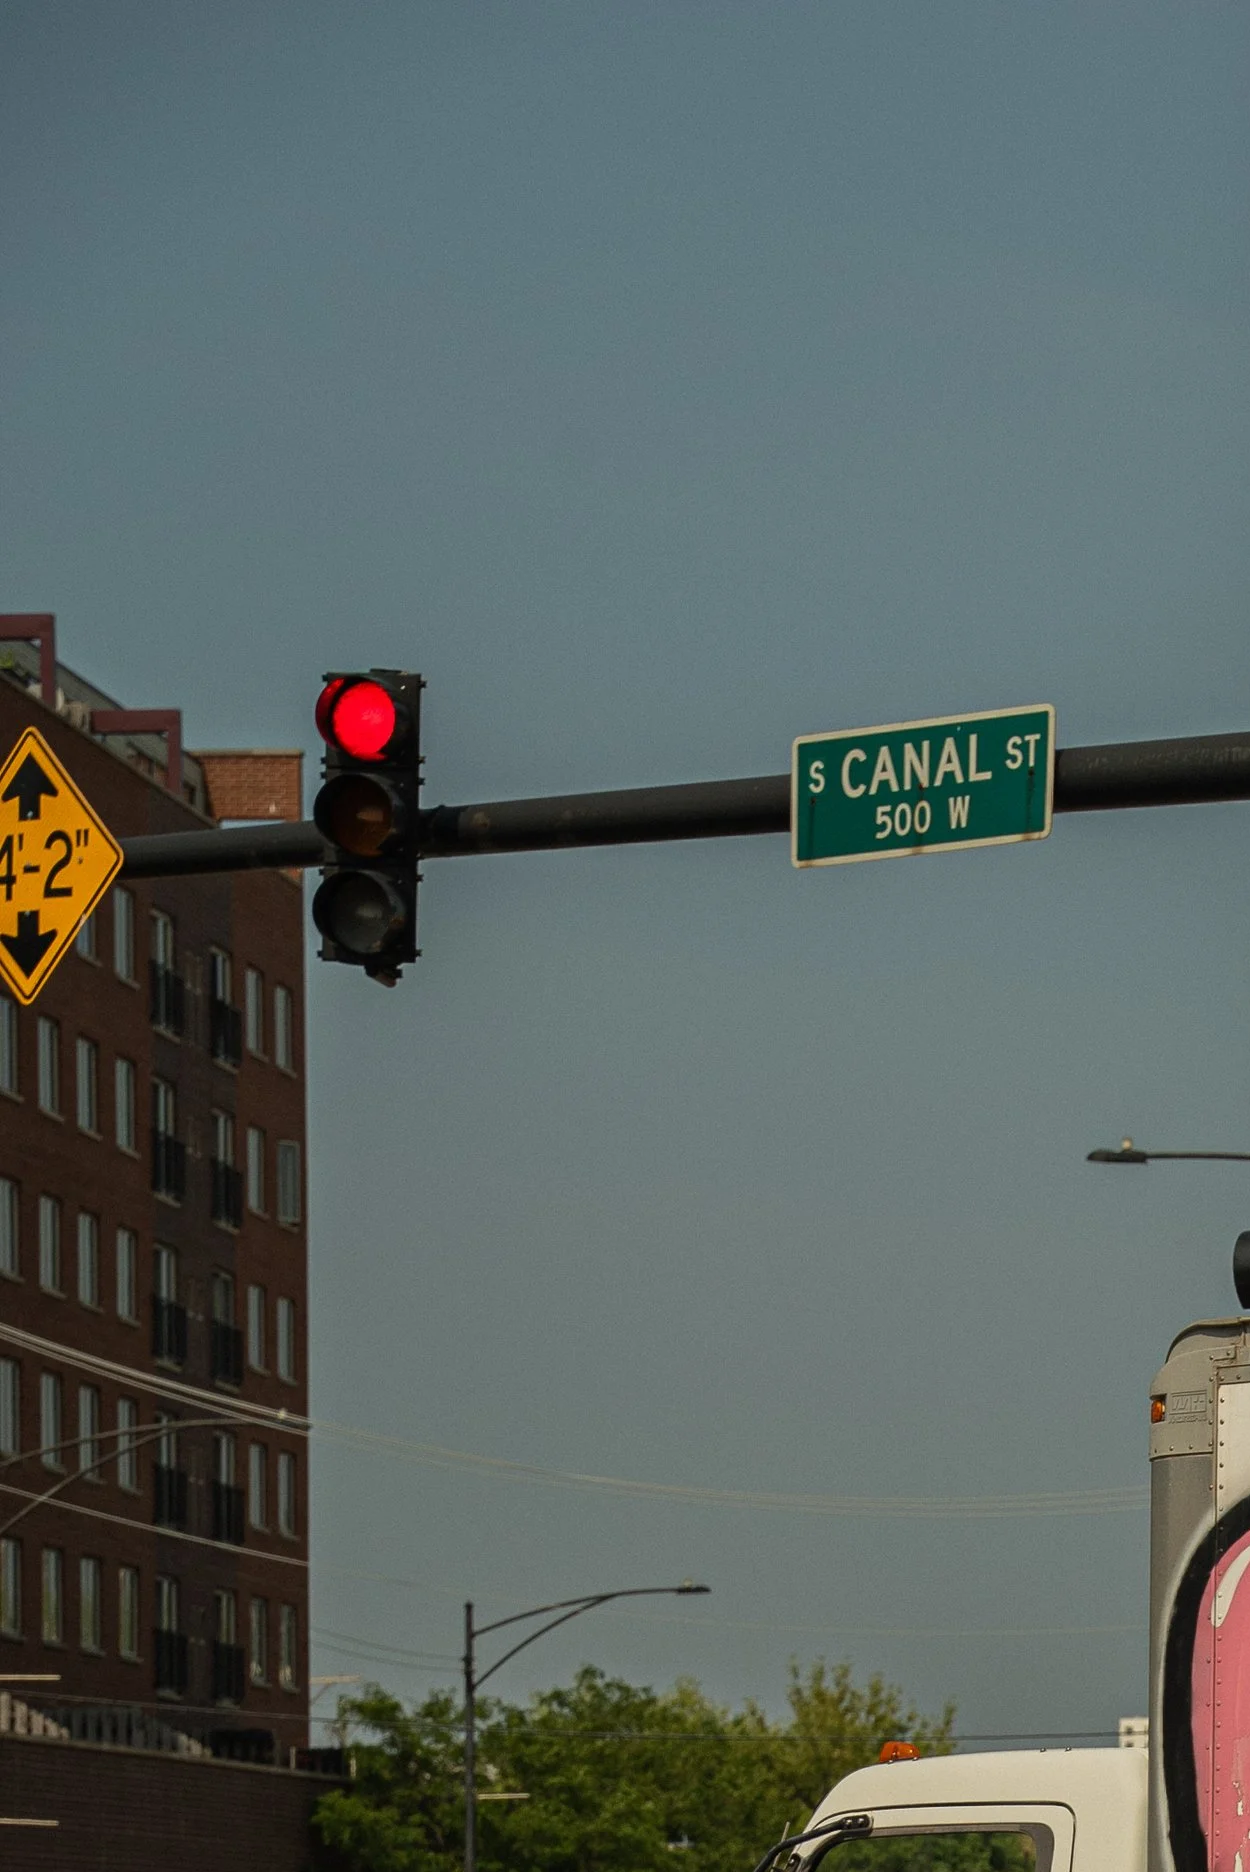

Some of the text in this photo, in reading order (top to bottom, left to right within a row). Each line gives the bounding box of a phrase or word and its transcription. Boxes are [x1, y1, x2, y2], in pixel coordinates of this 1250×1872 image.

[808, 733, 1041, 798] S CANAL ST
[875, 794, 970, 840] 500 W
